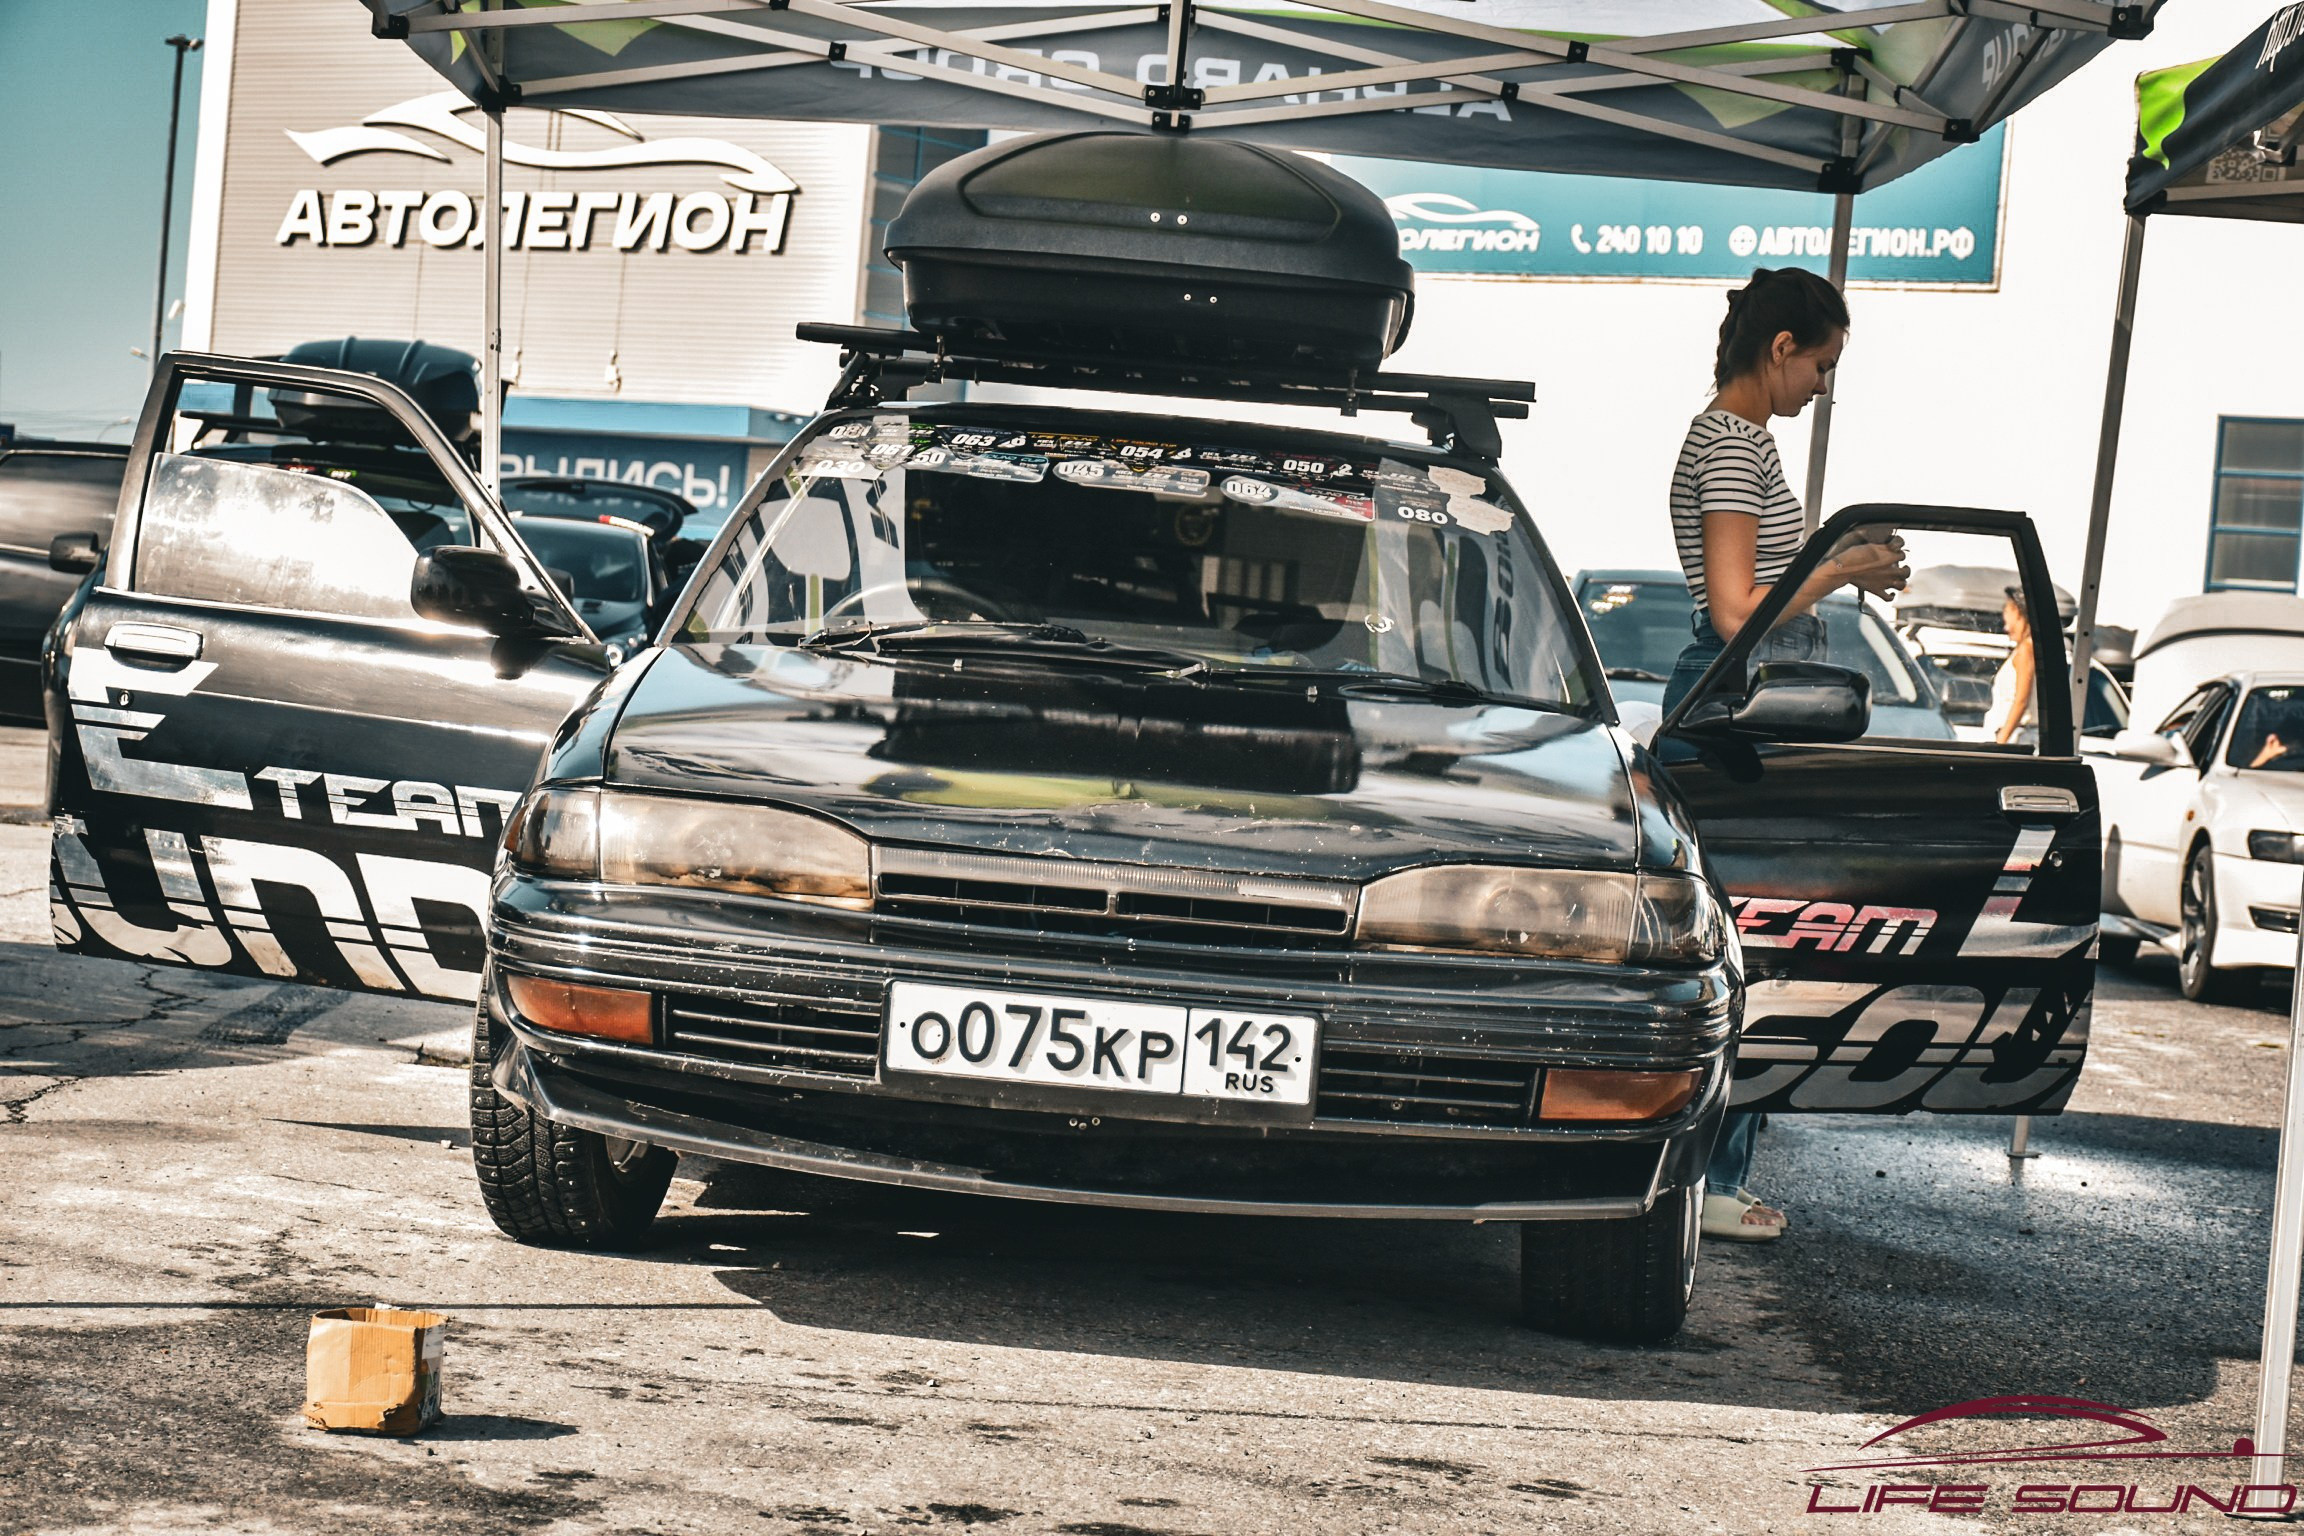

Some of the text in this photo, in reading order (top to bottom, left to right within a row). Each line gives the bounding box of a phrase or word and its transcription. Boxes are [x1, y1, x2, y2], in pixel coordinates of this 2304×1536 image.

[276, 189, 792, 252] АВТОЛЕГИОН
[1596, 224, 1704, 255] 240 10 10
[951, 433, 997, 447] 063
[870, 444, 915, 456] 061
[1120, 445, 1164, 459] 054
[1057, 462, 1105, 477] 045
[1283, 459, 1325, 473] 050
[1226, 481, 1272, 498] 064
[1397, 507, 1449, 525] 080
[911, 1000, 1292, 1080] О075КР 142
[1224, 1072, 1274, 1094] RUS
